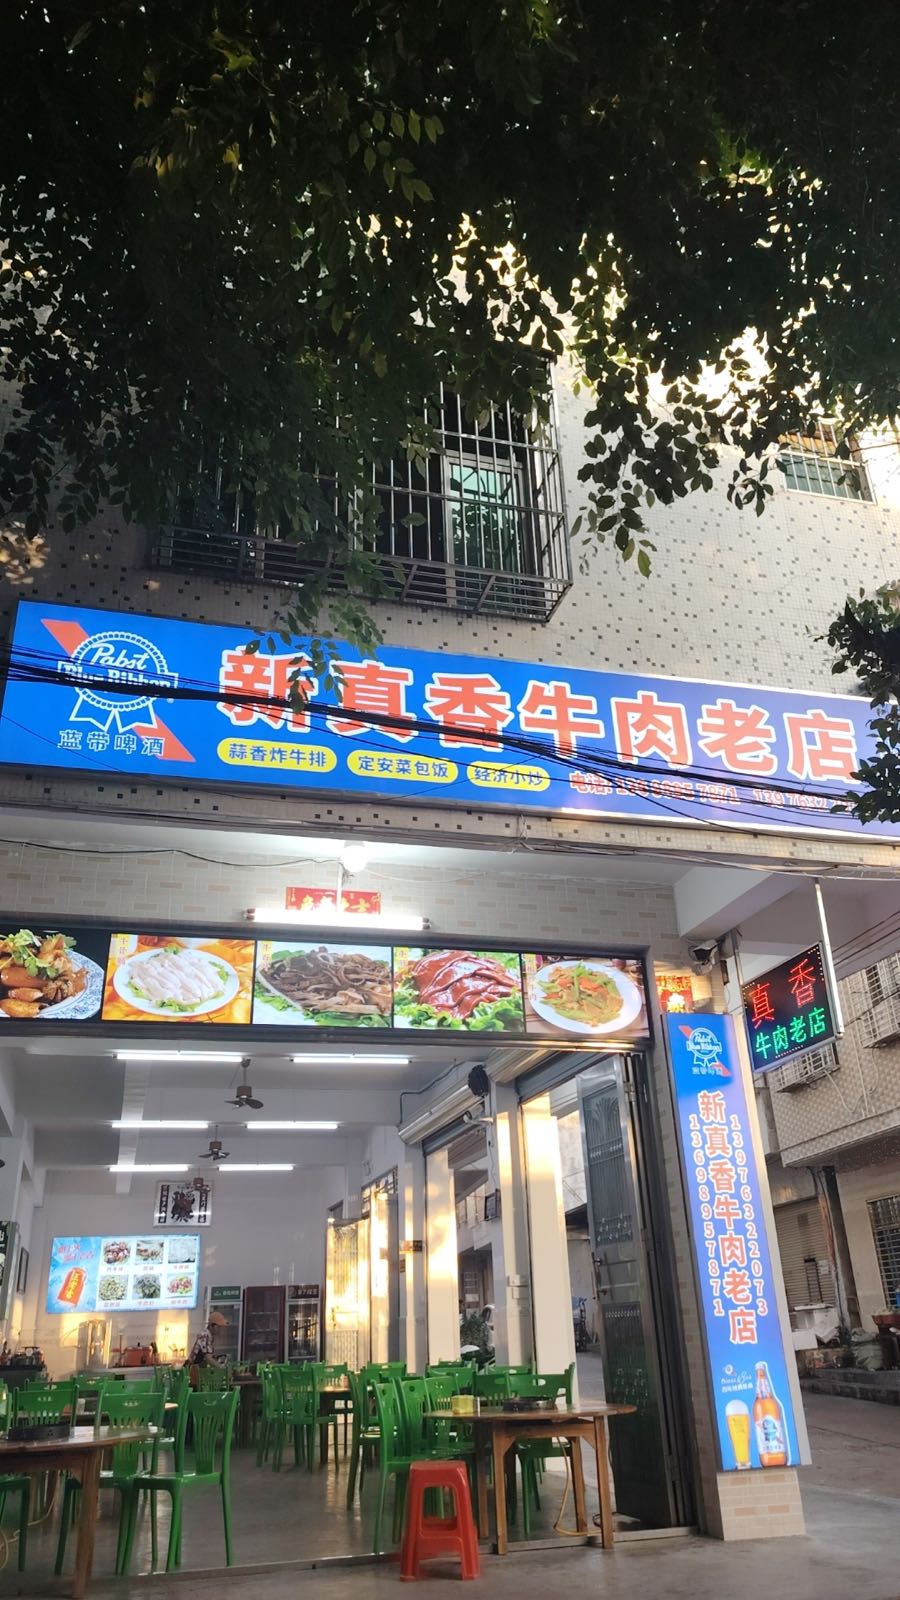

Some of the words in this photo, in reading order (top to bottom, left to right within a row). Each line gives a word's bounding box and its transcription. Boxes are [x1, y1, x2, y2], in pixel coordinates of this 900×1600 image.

[90, 642, 150, 671] Pabst
[216, 646, 861, 785] 新真香牛肉老店
[57, 729, 165, 757] 蓝带啤酒
[228, 742, 327, 767] 蒜香炸牛排
[358, 755, 449, 779] 定安菜包饭
[474, 766, 543, 786] 经济小炒
[749, 959, 816, 1029] 真香
[755, 1007, 826, 1059] 牛肉老店
[689, 1115, 724, 1317] 13698957871
[698, 1090, 758, 1344] 新真香牛肉老店
[730, 1115, 769, 1317] 13976322073
